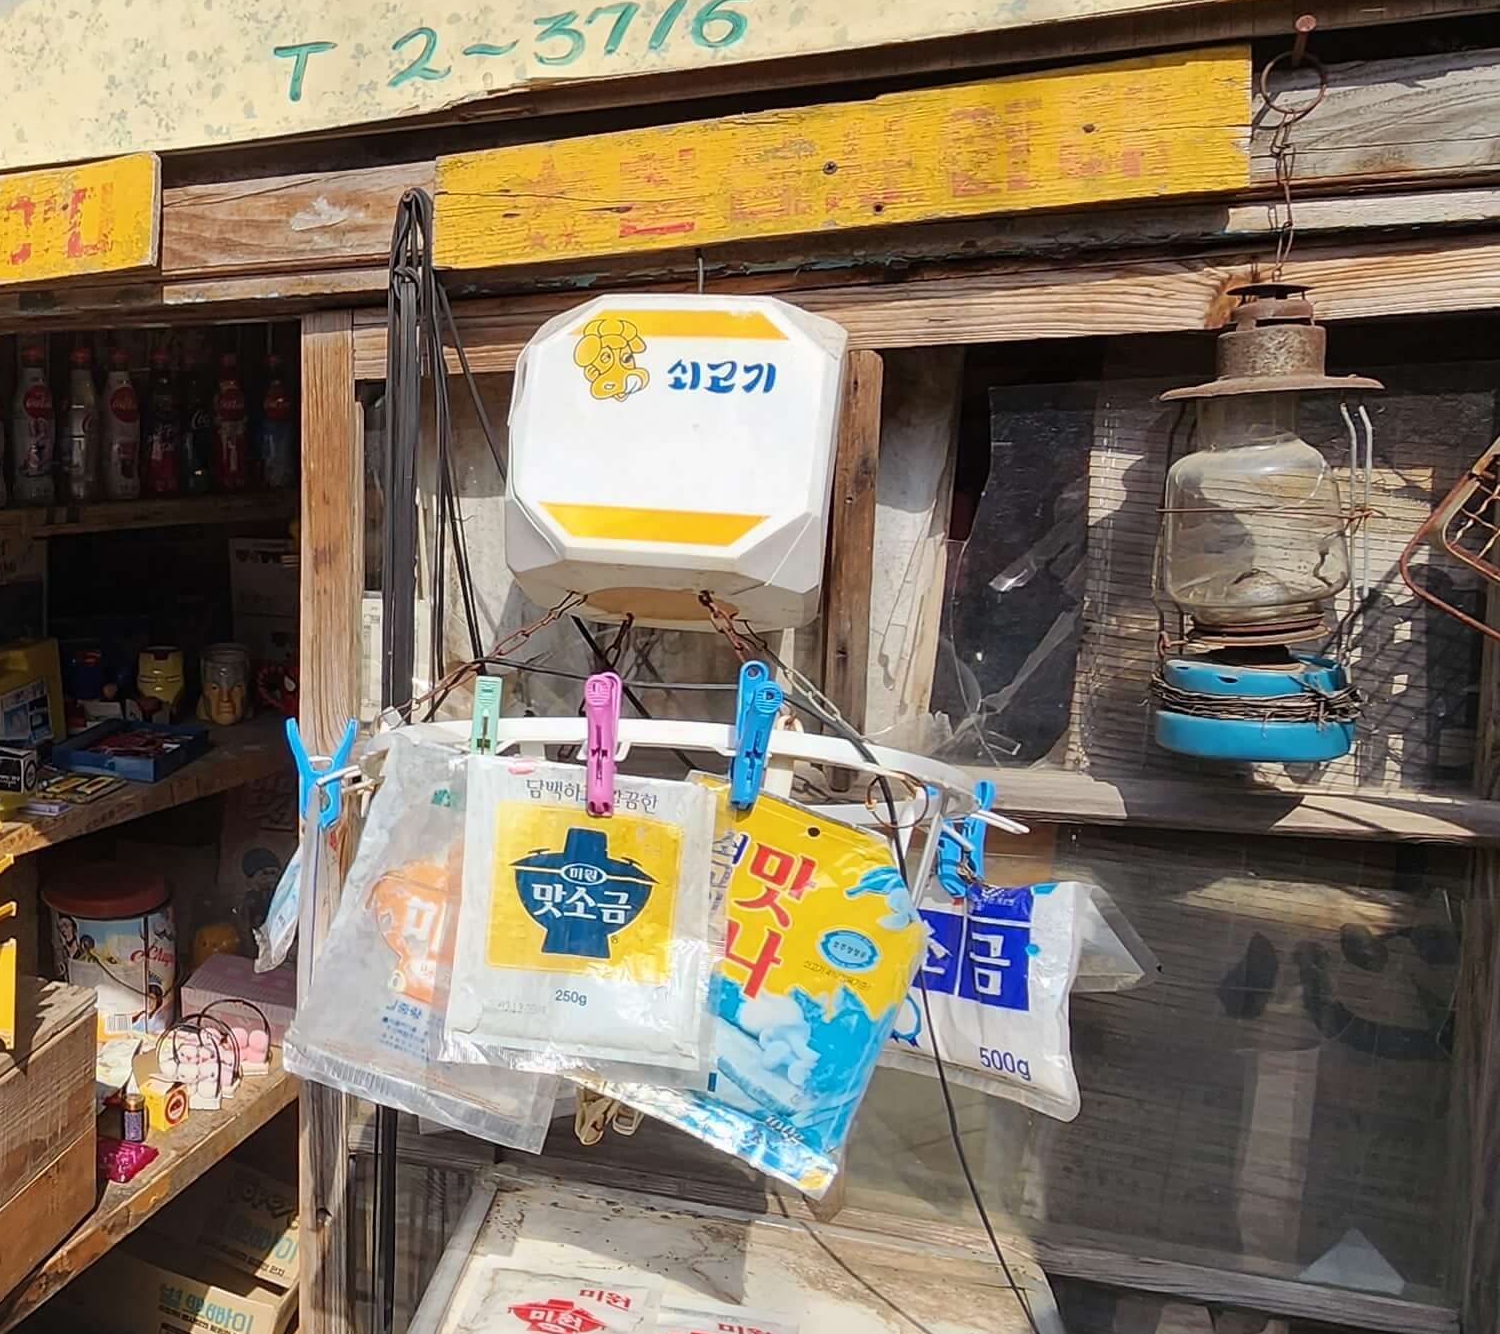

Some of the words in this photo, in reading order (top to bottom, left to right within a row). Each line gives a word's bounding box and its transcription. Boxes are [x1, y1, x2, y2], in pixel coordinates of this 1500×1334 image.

[273, 40, 338, 103] T
[666, 358, 778, 395] 쇠고기
[525, 778, 589, 804] 담백하
[568, 866, 599, 883] 미원
[531, 882, 632, 925] 맛소금
[555, 989, 588, 1007] 250g
[978, 1046, 1032, 1082] 500g
[579, 1288, 632, 1311] 미원
[529, 1308, 584, 1332] 미원
